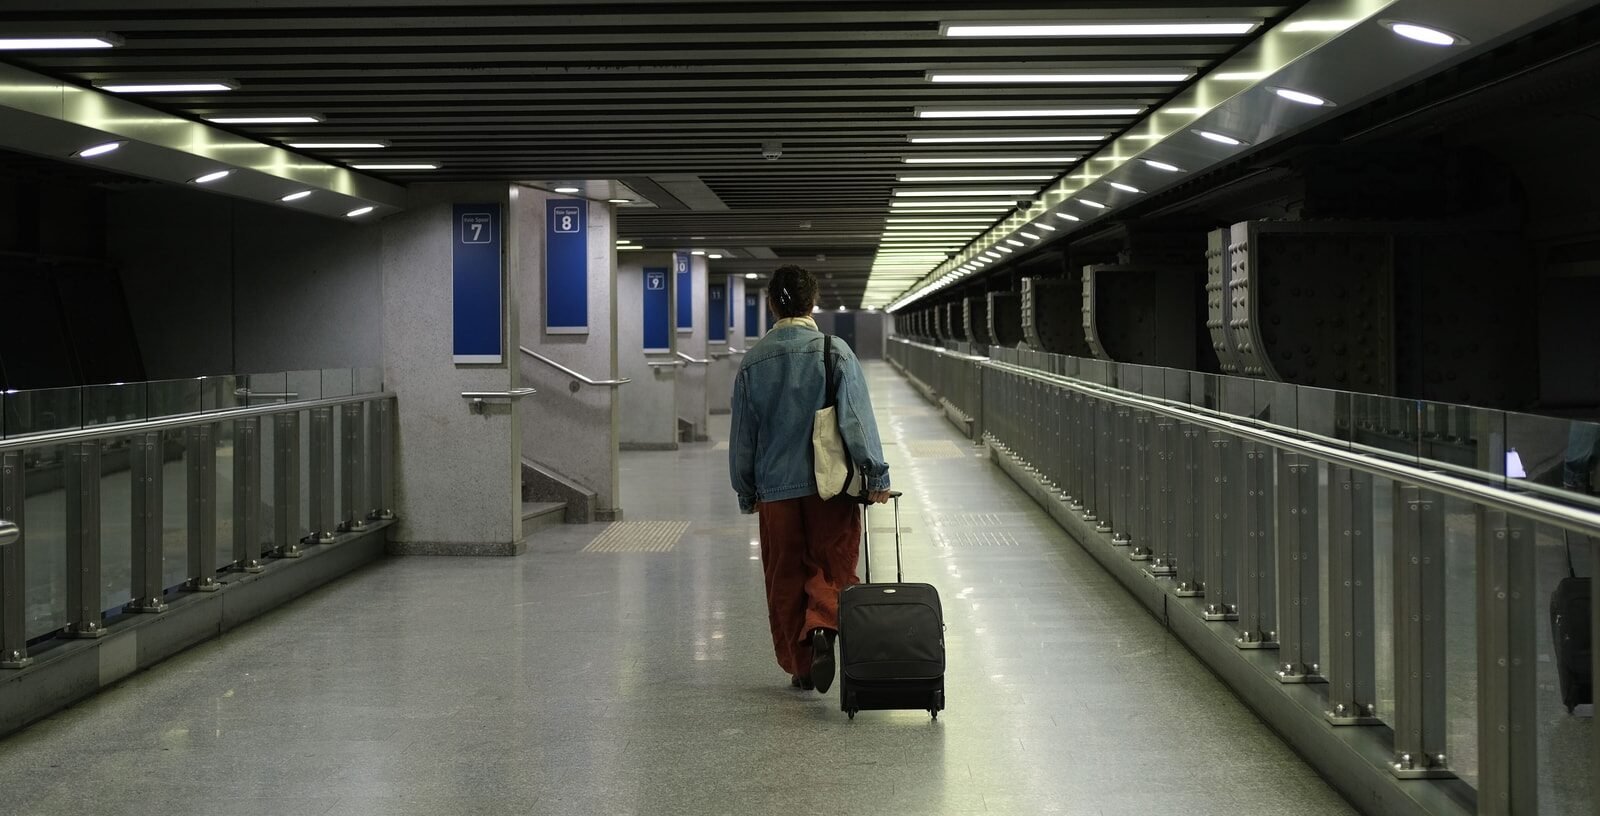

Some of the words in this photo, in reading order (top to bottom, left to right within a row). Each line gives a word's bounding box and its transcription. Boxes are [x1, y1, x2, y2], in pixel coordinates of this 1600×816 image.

[562, 216, 571, 230] 8
[471, 224, 482, 240] 7
[652, 278, 659, 288] 9
